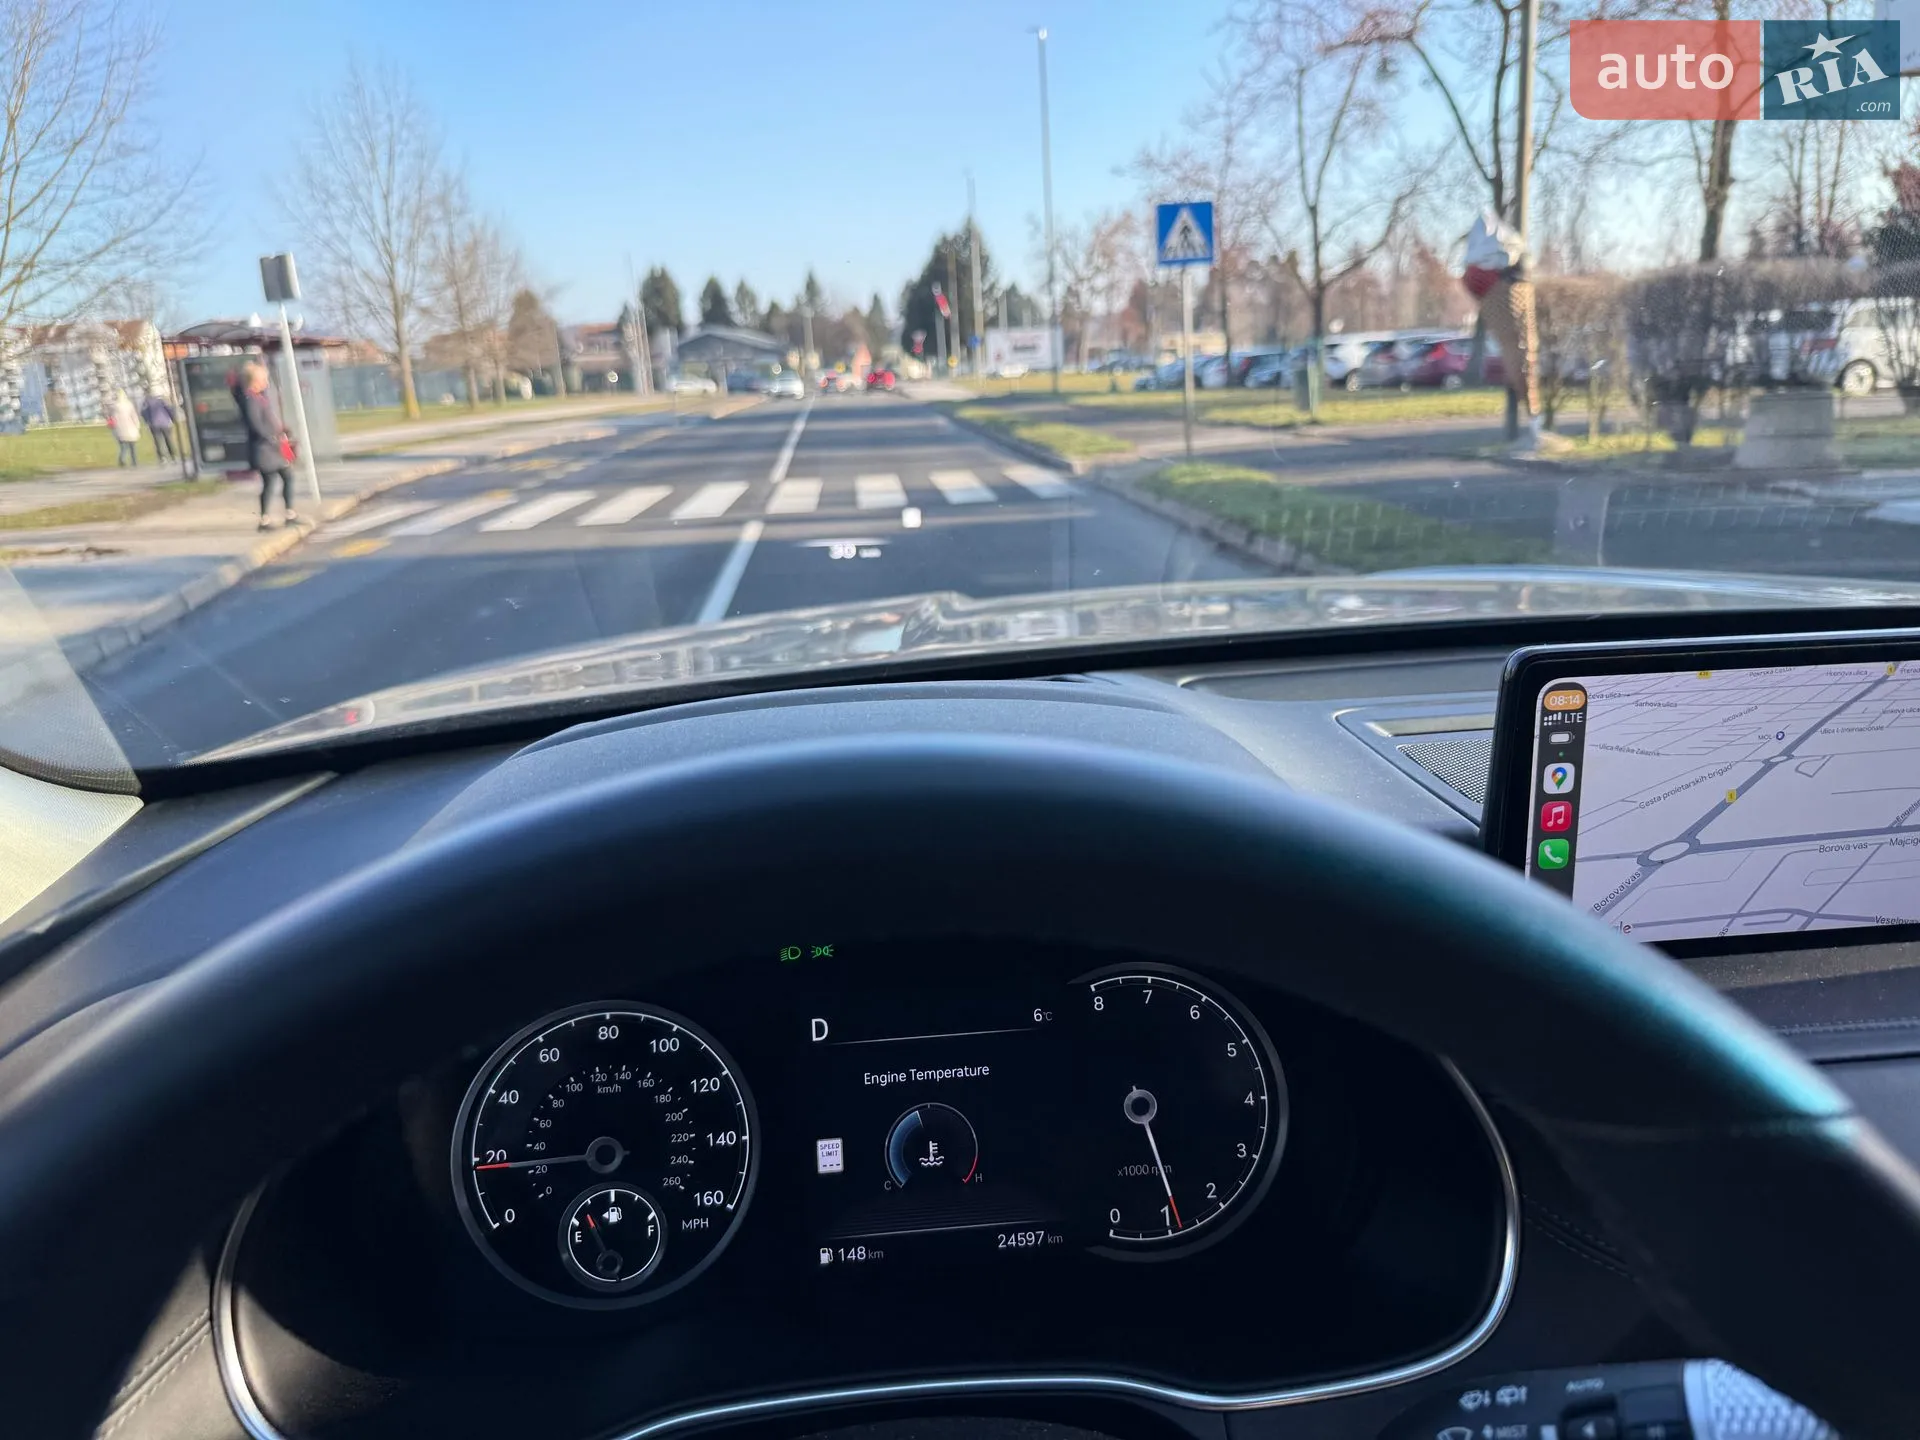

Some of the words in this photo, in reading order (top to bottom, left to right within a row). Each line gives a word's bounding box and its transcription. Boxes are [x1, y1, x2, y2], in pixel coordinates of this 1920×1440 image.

[1550, 694, 1580, 706] 08:14
[1564, 712, 1583, 724] LTE
[1818, 843, 1851, 853] Borova
[1593, 883, 1625, 912] Borova
[1625, 871, 1641, 886] vas
[1094, 996, 1104, 1010] 8
[1142, 989, 1152, 1004] 7
[1190, 1005, 1200, 1019] 6
[598, 1025, 619, 1040] 80
[811, 1018, 829, 1041] D
[649, 1037, 680, 1053] 100
[1227, 1043, 1237, 1057] 5
[539, 1047, 560, 1062] 60
[589, 1072, 607, 1083] 120
[614, 1070, 632, 1081] 140
[863, 1070, 907, 1086] Engine
[909, 1064, 990, 1082] Temperature
[565, 1082, 583, 1093] 100
[597, 1083, 622, 1095] km/h
[637, 1078, 655, 1089] 160
[690, 1077, 720, 1094] 120
[498, 1089, 520, 1105] 40
[552, 1098, 565, 1108] 80
[654, 1093, 672, 1104] 180
[1244, 1091, 1255, 1105] 4
[539, 1119, 552, 1128] 60
[665, 1112, 683, 1122] 200
[671, 1132, 689, 1142] 220
[706, 1131, 736, 1146] 140
[533, 1141, 546, 1151] 40
[820, 1143, 840, 1151] SPEED
[1236, 1143, 1247, 1158] 3
[486, 1149, 507, 1163] 20
[670, 1154, 688, 1165] 240
[821, 1150, 839, 1158] LIMIT
[535, 1164, 548, 1174] 20
[1117, 1164, 1149, 1177] x1000
[663, 1176, 681, 1187] 260
[975, 1173, 983, 1183] H
[545, 1186, 553, 1195] 0
[884, 1180, 891, 1190] C
[1206, 1182, 1217, 1198] 2
[694, 1190, 724, 1206] 160
[505, 1208, 516, 1223] 0
[1110, 1208, 1121, 1223] 0
[1160, 1205, 1170, 1227] 1
[682, 1217, 709, 1230] MPH
[575, 1231, 582, 1243] E
[647, 1225, 655, 1237] F
[997, 1231, 1045, 1248] 24597
[1047, 1233, 1063, 1244] km
[838, 1246, 866, 1261] 148
[868, 1248, 884, 1259] km
